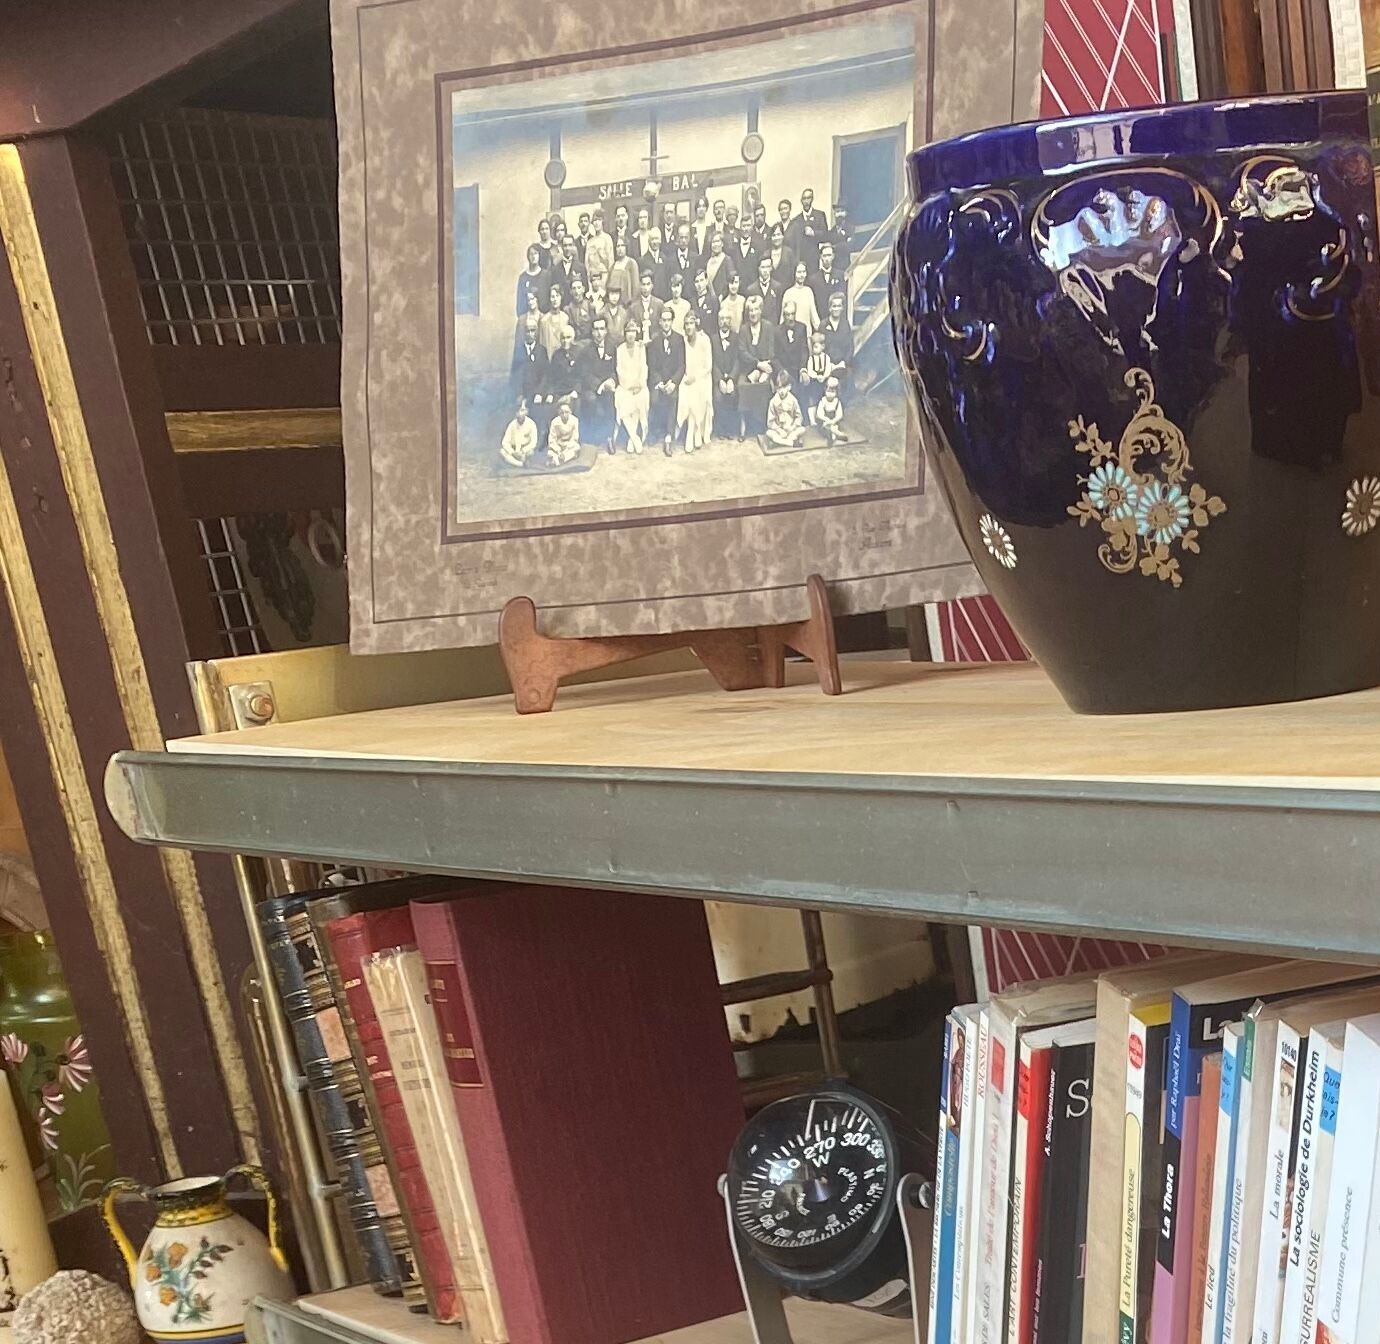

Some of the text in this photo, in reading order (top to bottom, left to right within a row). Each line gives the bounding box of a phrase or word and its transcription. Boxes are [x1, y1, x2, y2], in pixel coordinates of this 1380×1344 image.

[598, 182, 633, 200] SALLE
[672, 173, 699, 191] BAL
[978, 1023, 989, 1099] ROUSSEAU
[803, 1137, 836, 1160] 270
[840, 1132, 871, 1147] 300
[1290, 1050, 1320, 1267] La sociologie de Durkheim
[1126, 1168, 1136, 1245] dangereuse
[1161, 1163, 1175, 1240] La Thora
[1231, 1178, 1243, 1244] politique
[1270, 1149, 1284, 1221] La morale
[1230, 1246, 1238, 1265] du
[1331, 1186, 1353, 1324] Commune présence
[1205, 1264, 1215, 1310] Le lied
[1225, 1267, 1237, 1328] fragilité
